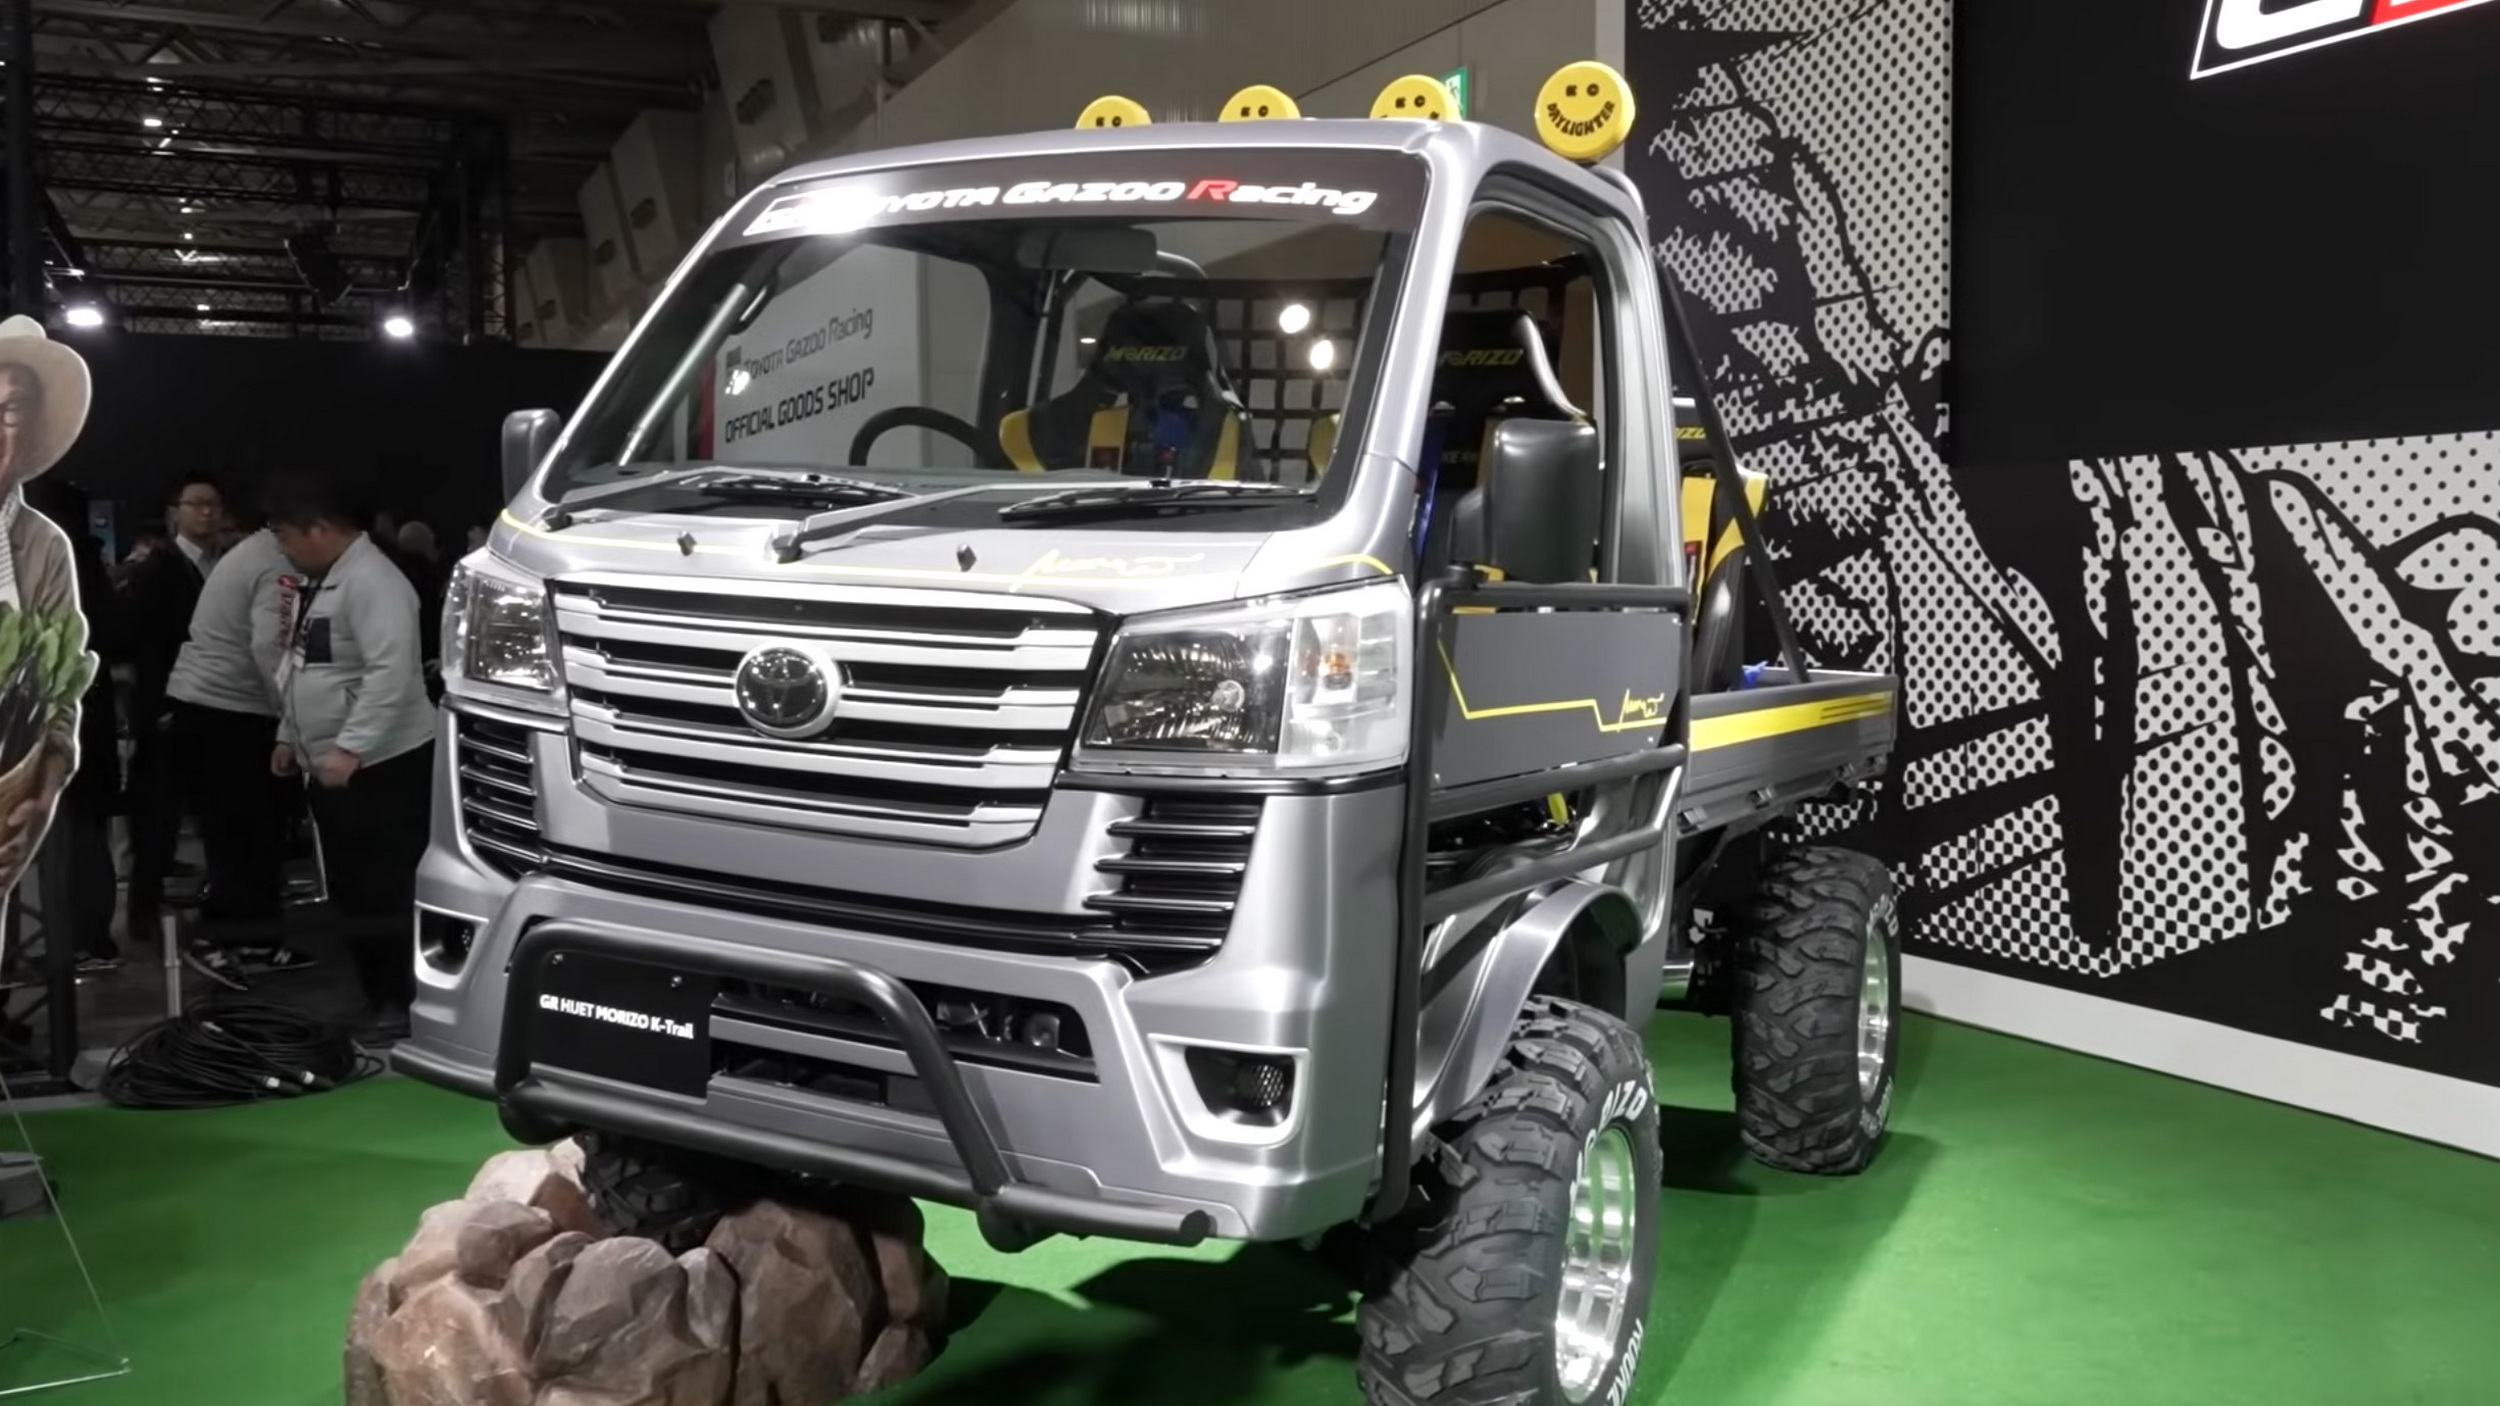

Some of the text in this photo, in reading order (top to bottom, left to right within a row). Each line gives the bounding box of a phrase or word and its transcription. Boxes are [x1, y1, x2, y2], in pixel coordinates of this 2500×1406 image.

[1547, 100, 1616, 137] DAYLIGHTER
[1003, 181, 1186, 204] GAZOO
[1186, 179, 1378, 215] Racing
[785, 327, 827, 364] GAZOO
[829, 308, 874, 343] Racing
[725, 367, 875, 443] OFFICIAL GOODS SHOP
[539, 993, 694, 1039] GR HUET MORIZO K-Trail
